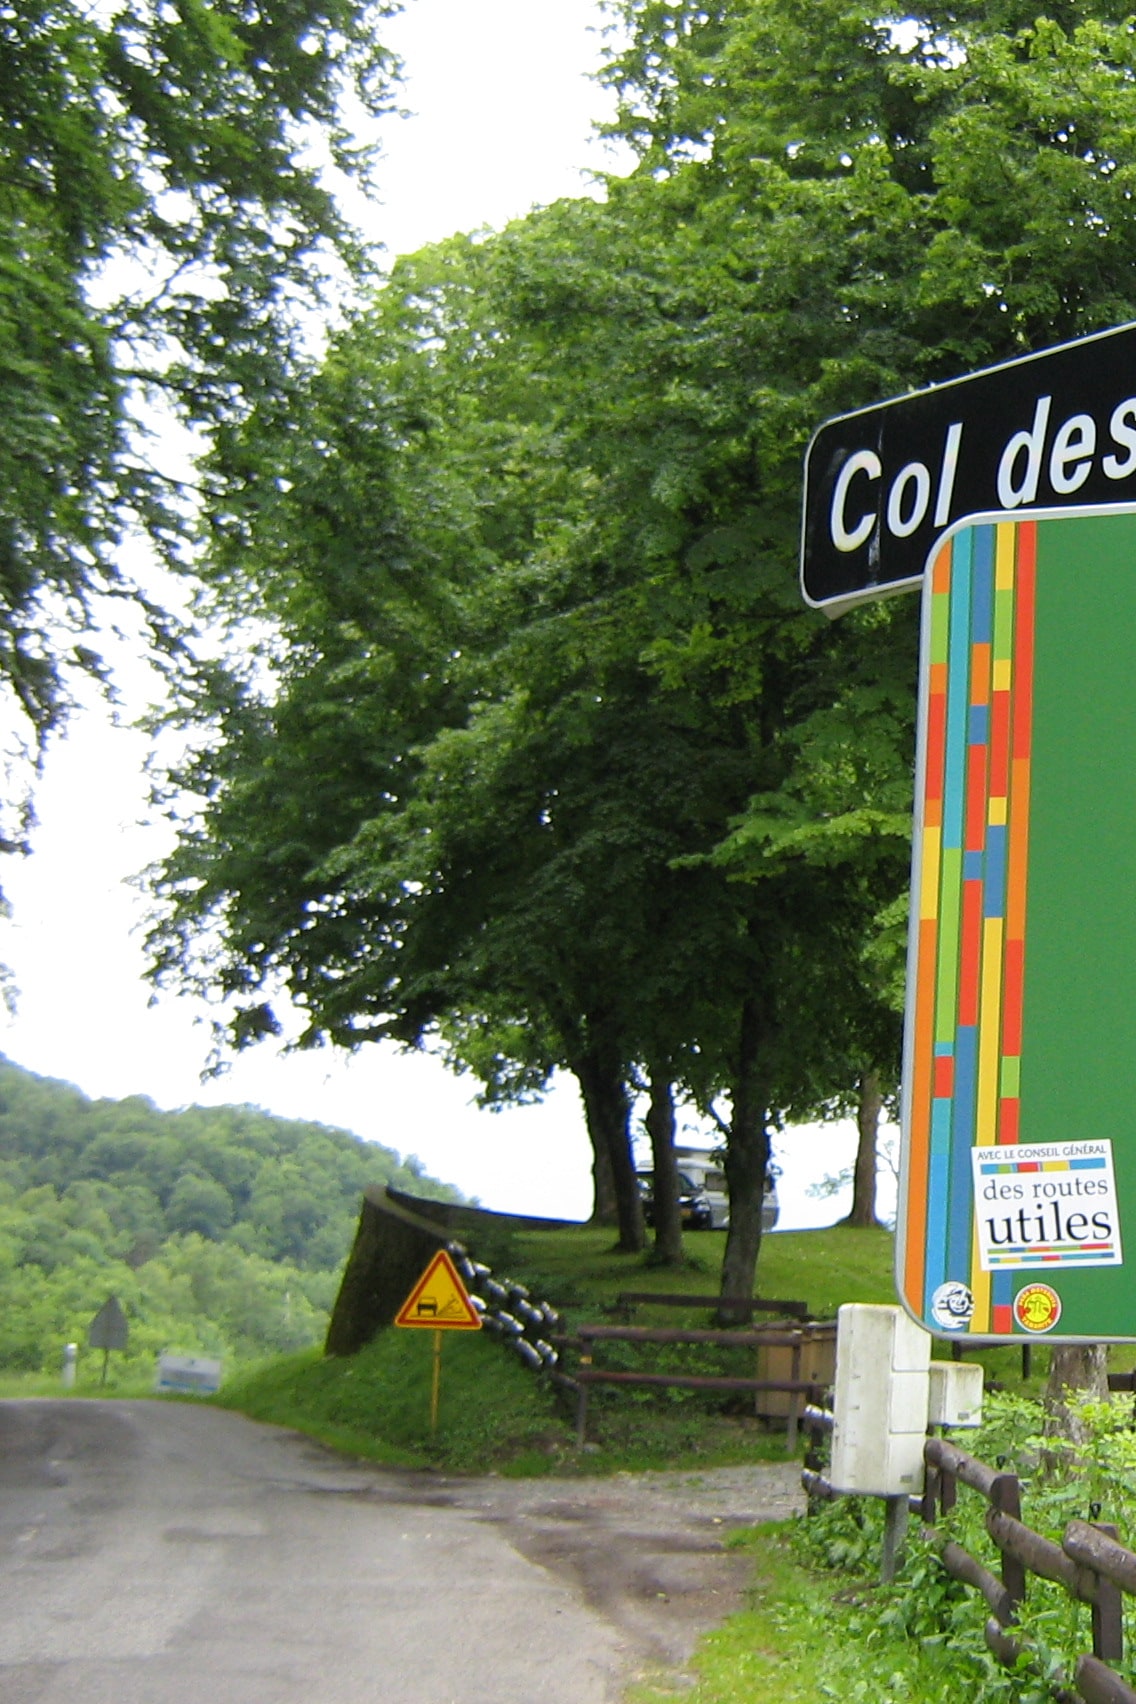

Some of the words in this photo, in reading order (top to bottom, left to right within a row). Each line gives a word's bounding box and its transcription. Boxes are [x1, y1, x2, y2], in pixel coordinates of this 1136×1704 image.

[831, 422, 963, 552] Col
[977, 1151, 1003, 1160] AVEC
[1004, 1150, 1015, 1159] LE
[1018, 1147, 1060, 1158] CONSEIL
[1062, 1144, 1107, 1156] GÉNÉRAL
[983, 1179, 1024, 1200] des
[1032, 1177, 1108, 1198] routes
[985, 1200, 1112, 1245] utiles
